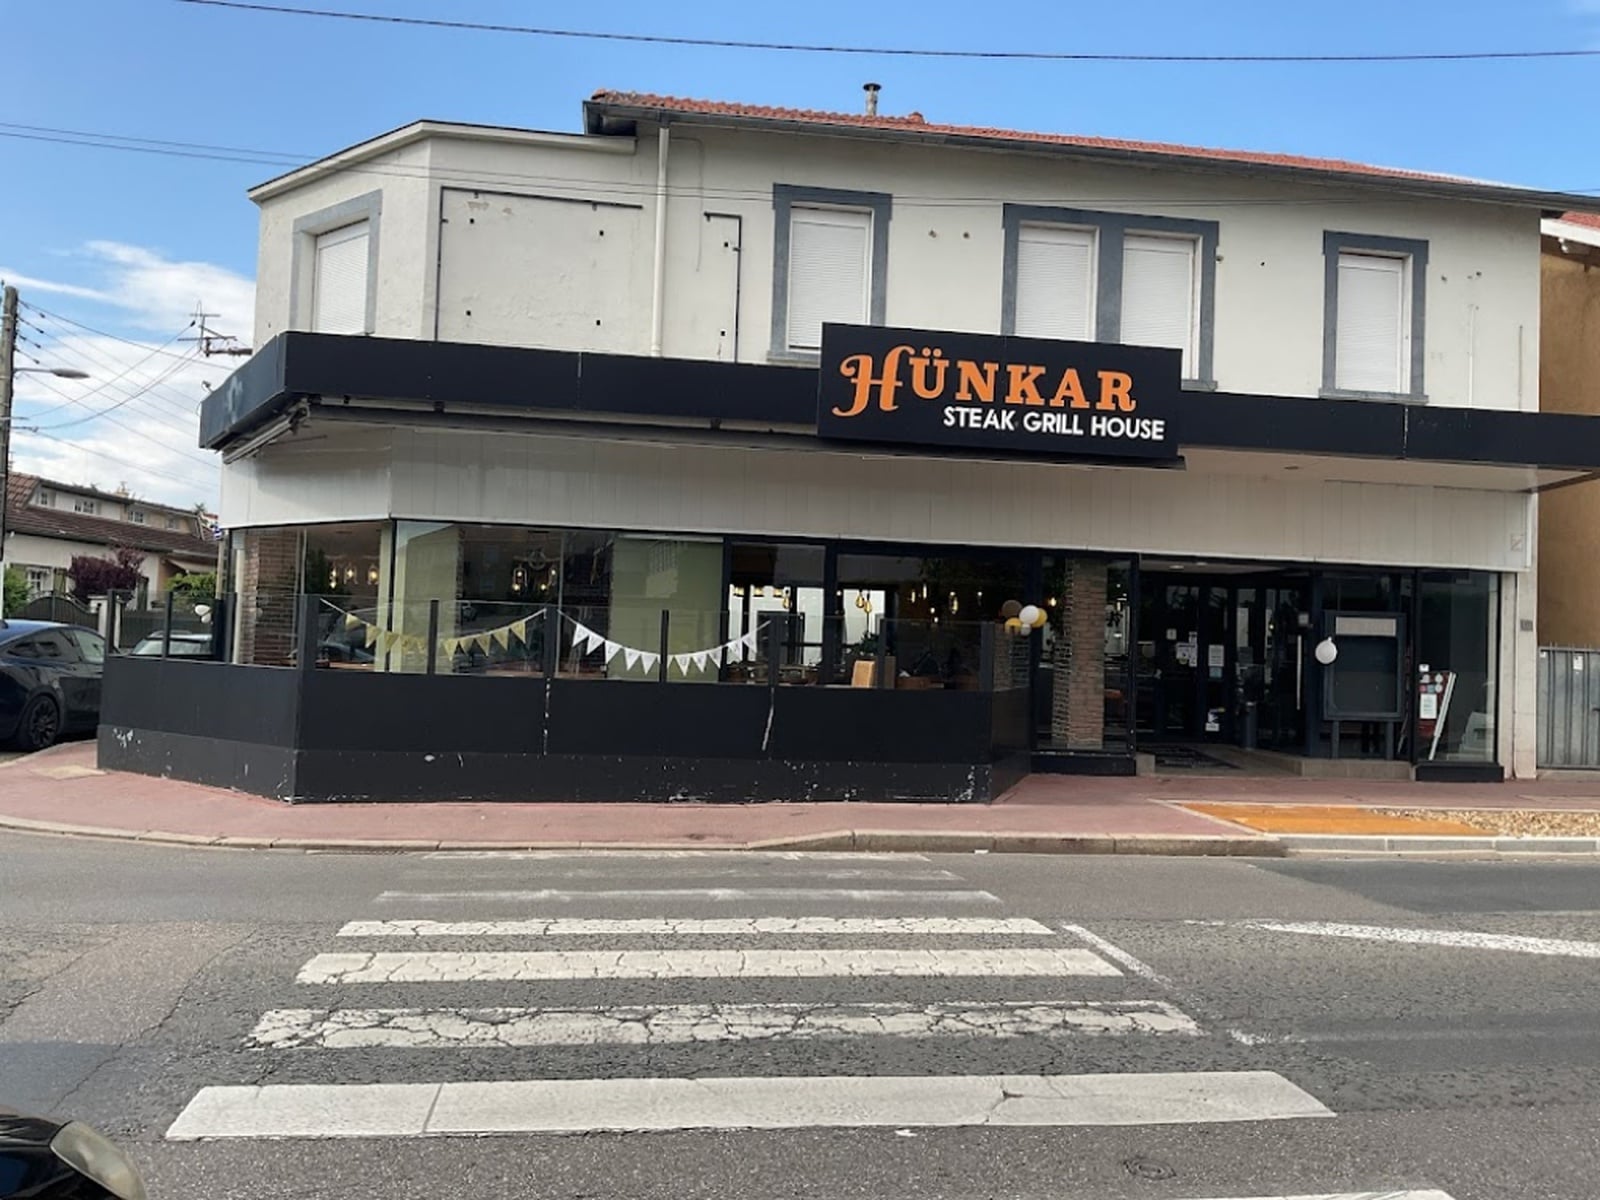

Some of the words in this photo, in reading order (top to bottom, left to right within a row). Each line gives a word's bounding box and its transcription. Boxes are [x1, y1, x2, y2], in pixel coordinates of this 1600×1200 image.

[832, 346, 1136, 417] HÜNKAR
[943, 406, 1015, 431] STEAK
[1023, 411, 1083, 436] GRILL
[1091, 416, 1165, 440] HOUSE
